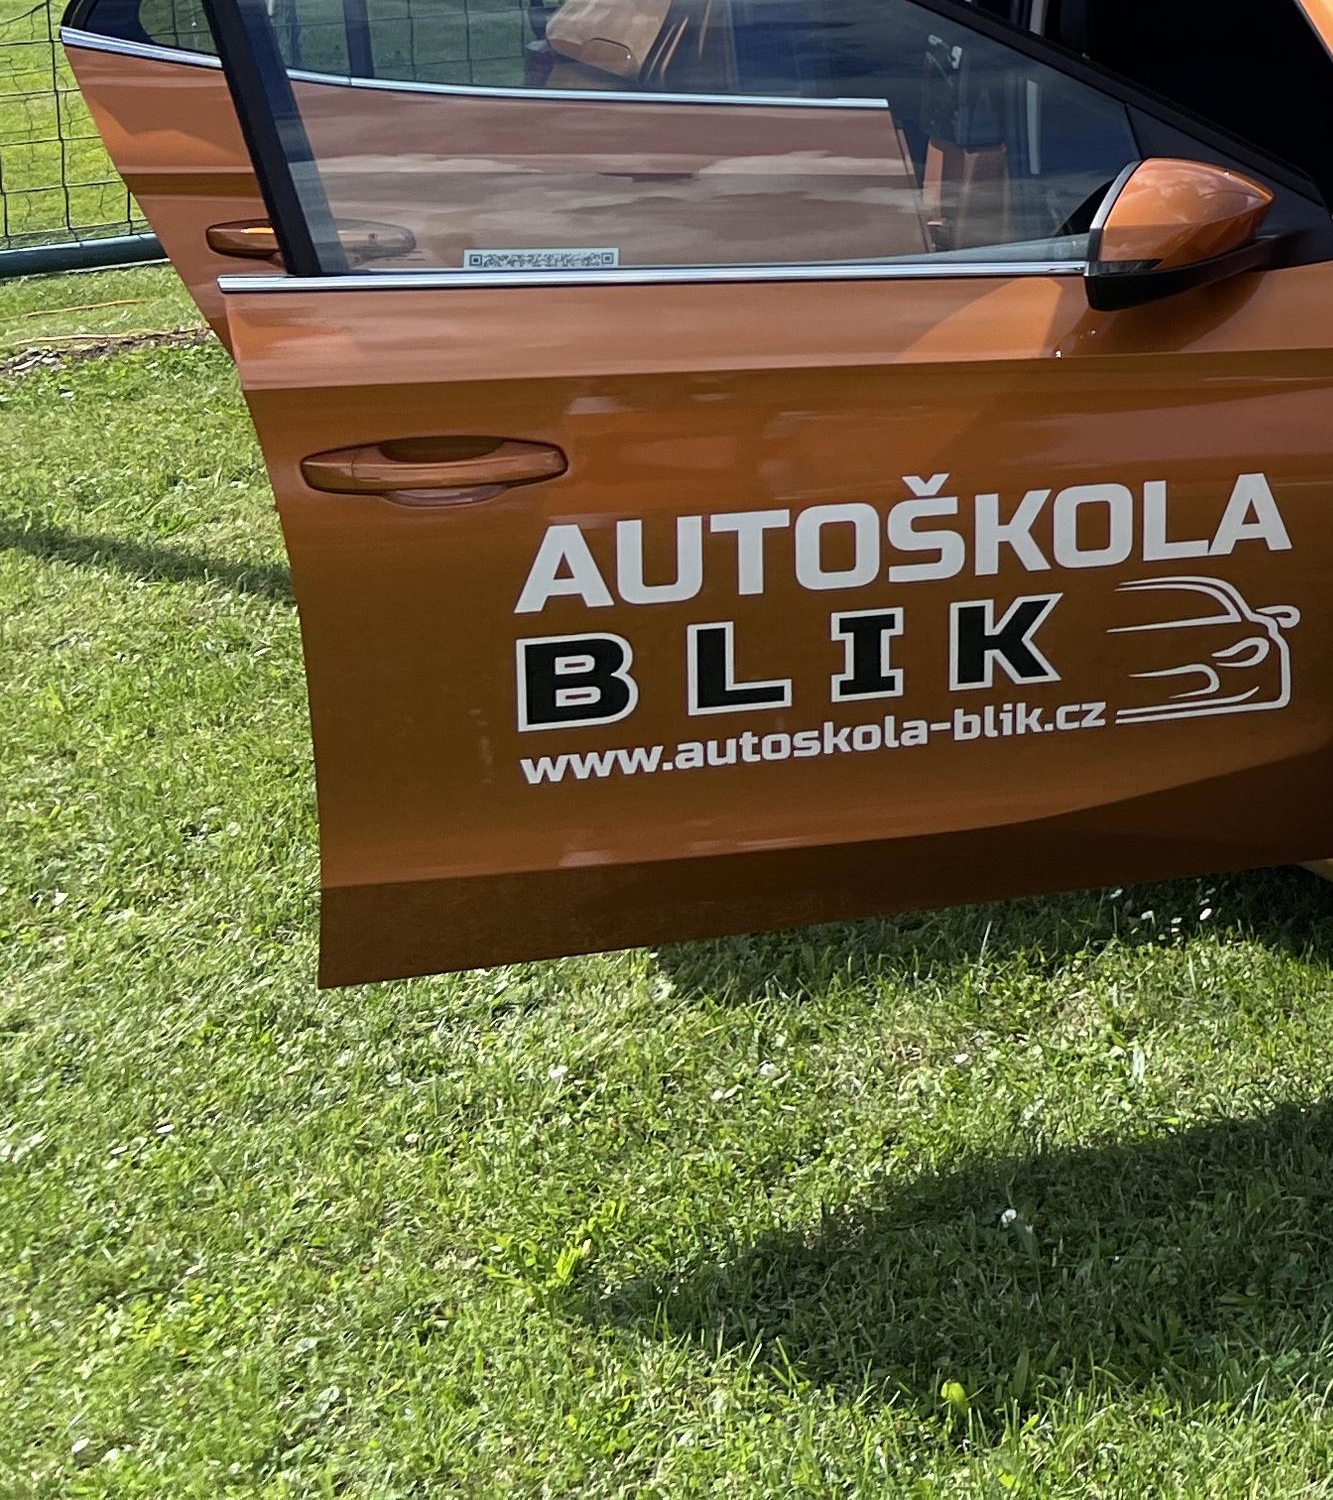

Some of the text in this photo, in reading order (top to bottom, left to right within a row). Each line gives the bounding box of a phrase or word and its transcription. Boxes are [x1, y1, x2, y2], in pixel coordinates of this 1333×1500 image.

[513, 473, 1293, 614] AUTOŠKOLA
[515, 592, 1064, 733] BLIK
[520, 701, 1108, 786] www.autoskola-blik.cz
